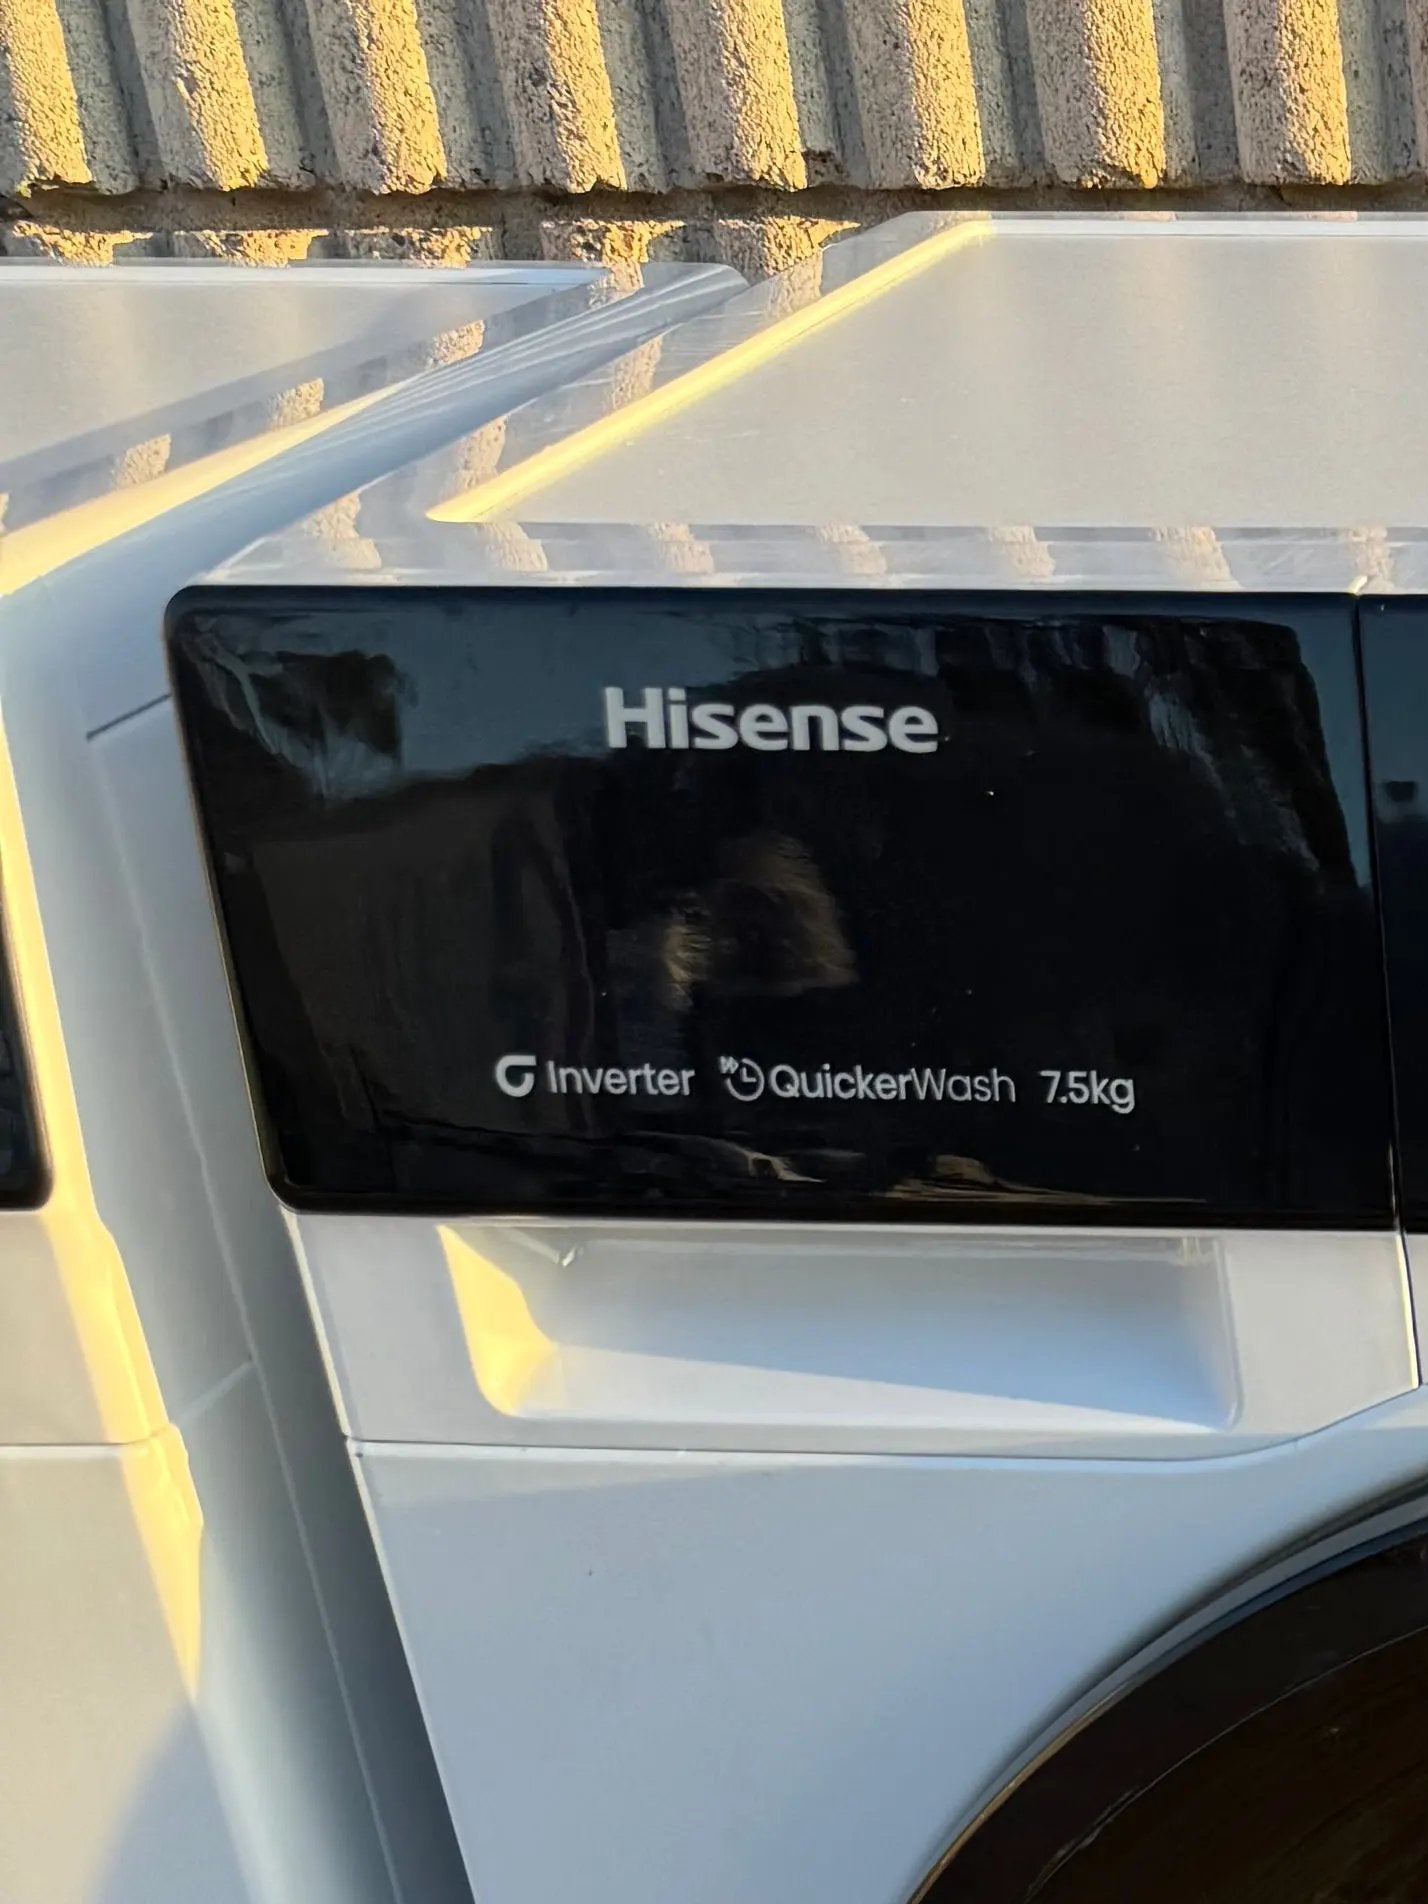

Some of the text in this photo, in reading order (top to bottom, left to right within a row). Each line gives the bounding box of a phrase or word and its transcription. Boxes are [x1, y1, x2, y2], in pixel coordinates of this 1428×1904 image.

[603, 686, 938, 753] Hisense
[546, 1058, 694, 1096] Inverter
[769, 1063, 1135, 1114] QuickerWash 7.5kg
